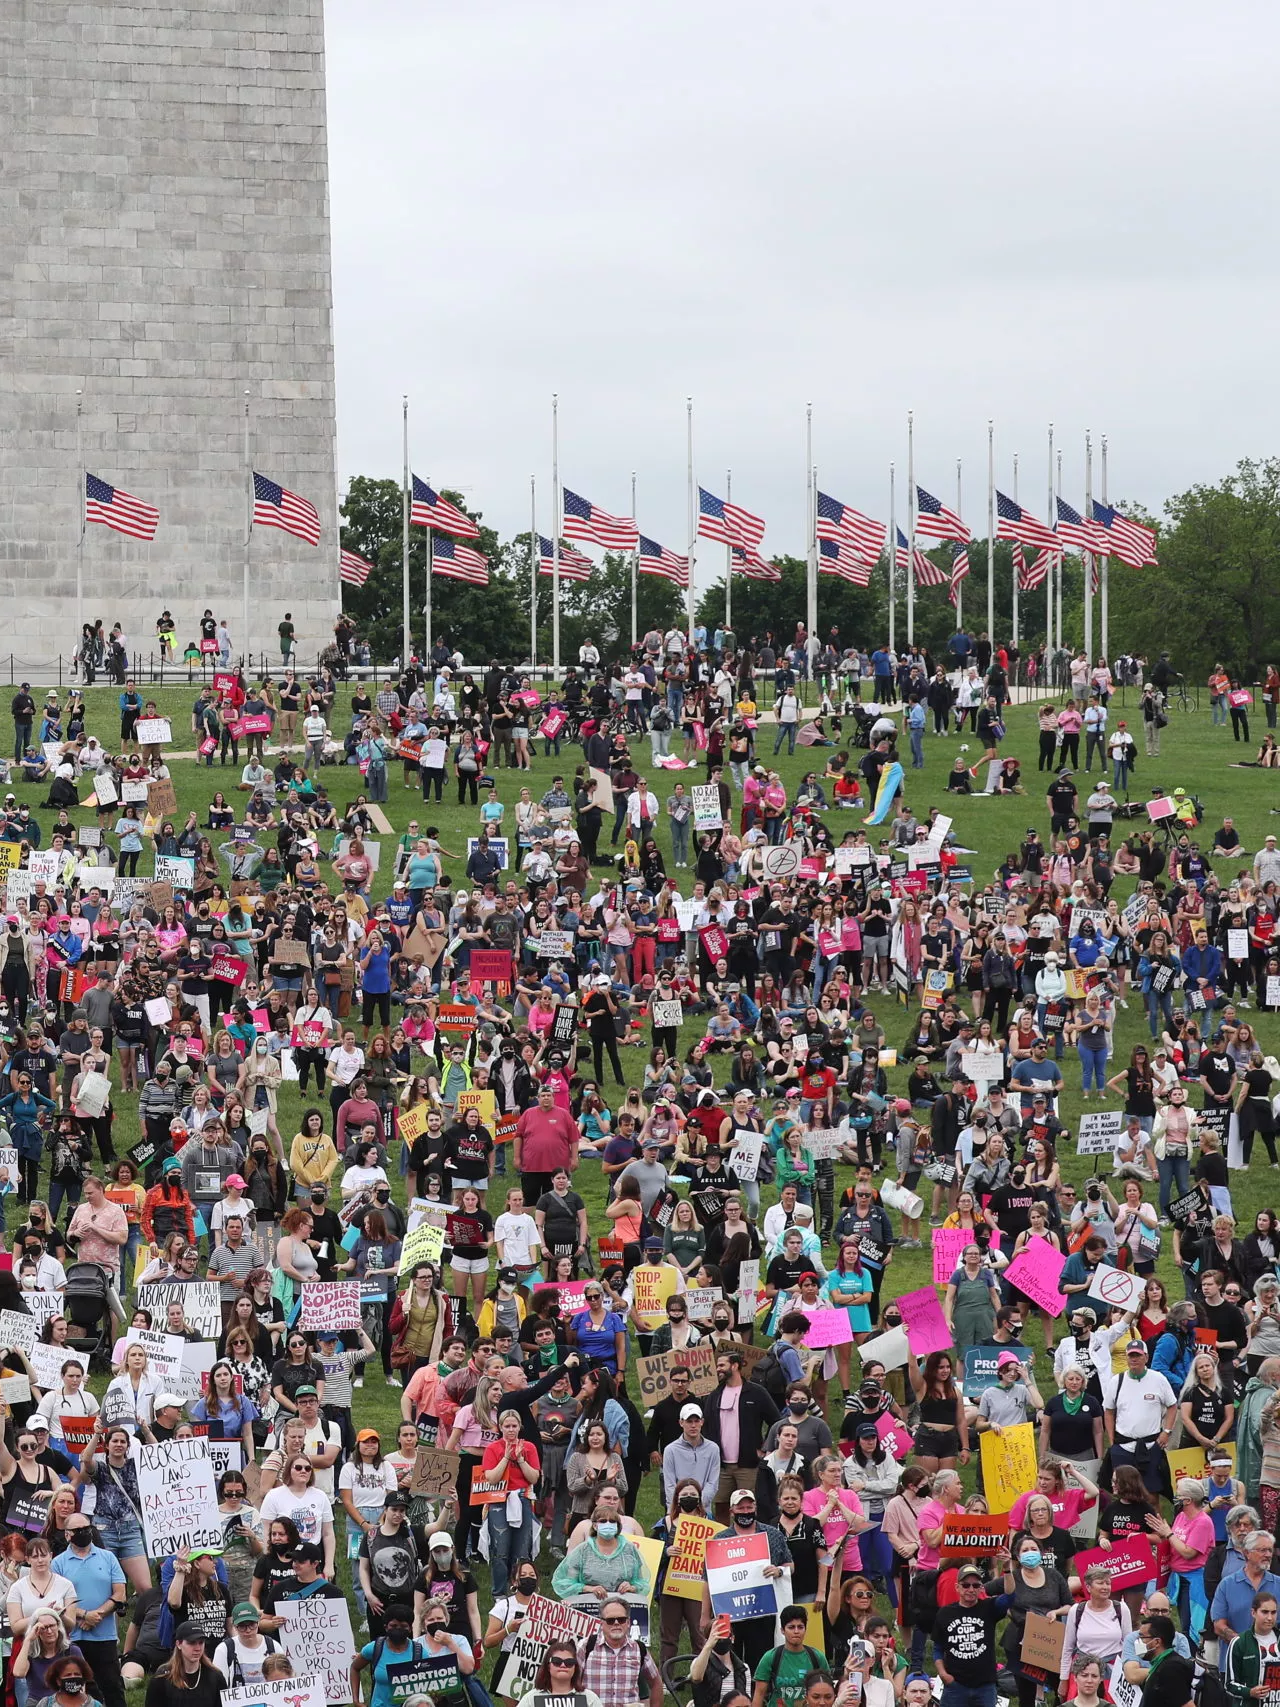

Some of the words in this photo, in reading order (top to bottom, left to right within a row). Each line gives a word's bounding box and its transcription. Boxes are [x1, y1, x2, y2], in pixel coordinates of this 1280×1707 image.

[156, 857, 170, 866] WE
[31, 864, 55, 873] BANS
[171, 877, 193, 887] BACK!
[1074, 909, 1090, 918] KEEP
[558, 1007, 574, 1018] HOW
[556, 1017, 573, 1028] DARE
[554, 1028, 571, 1040] THEY.
[1100, 1121, 1119, 1129] MADDER
[1100, 1129, 1120, 1137] MADNESS
[734, 1151, 753, 1163] ME
[554, 1244, 572, 1255] HOW
[600, 1251, 623, 1259] MAJORITY
[636, 1271, 662, 1284] STOP.
[139, 1285, 186, 1303] ABORTION
[303, 1281, 359, 1294] WOMEN'S
[636, 1285, 656, 1296] THE.
[1008, 1272, 1033, 1295] HUMAN
[1031, 1292, 1059, 1314] RIGHTS
[32, 1295, 63, 1309] ONLY
[302, 1289, 360, 1308] BODIES
[637, 1298, 663, 1311] BANS.
[303, 1307, 326, 1317] ARE
[328, 1300, 360, 1312] MORE
[2, 1311, 37, 1325] ABORTION
[302, 1309, 360, 1324] REGULATED
[4, 1319, 33, 1331] RIGHTS
[334, 1320, 361, 1330] GUNS
[0, 1330, 32, 1343] HUMAN
[0, 1337, 30, 1348] RIGHTS
[139, 1332, 166, 1344] PUBLIC
[646, 1357, 668, 1376] WE
[641, 1376, 667, 1394] GO
[138, 1437, 212, 1475] ABORTION
[161, 1462, 191, 1485] LAWS
[144, 1485, 207, 1512] RACIST,
[17, 1500, 48, 1514] Abortion
[152, 1514, 200, 1536] SEXIST
[1126, 1522, 1141, 1530] OUR
[152, 1530, 222, 1557] PRIVILEGED
[943, 1534, 1005, 1547] MAJORITY
[676, 1538, 704, 1557] THE.
[727, 1548, 746, 1559] OMG
[1121, 1560, 1145, 1570] Care.
[731, 1569, 749, 1582] GOP
[731, 1594, 756, 1607] WTF?
[298, 1601, 327, 1616] PRO
[527, 1593, 602, 1635] REPRODUCTIVE
[188, 1613, 206, 1621] AND
[283, 1616, 339, 1633] CHOICE
[947, 1618, 961, 1632] OUR
[957, 1626, 975, 1634] OUR
[301, 1631, 326, 1643] PRO
[948, 1630, 984, 1643] FUTURES
[512, 1636, 545, 1661] ABOUT
[950, 1644, 987, 1660] ABORTIONS
[959, 1642, 974, 1651] OUR
[306, 1658, 331, 1671] PRO
[391, 1666, 457, 1684] ABORTION
[517, 1662, 536, 1682] NOT
[221, 1687, 242, 1701] THE
[244, 1684, 271, 1699] LOGIC
[296, 1676, 317, 1693] IDIOT
[393, 1676, 458, 1697] ALWAYS
